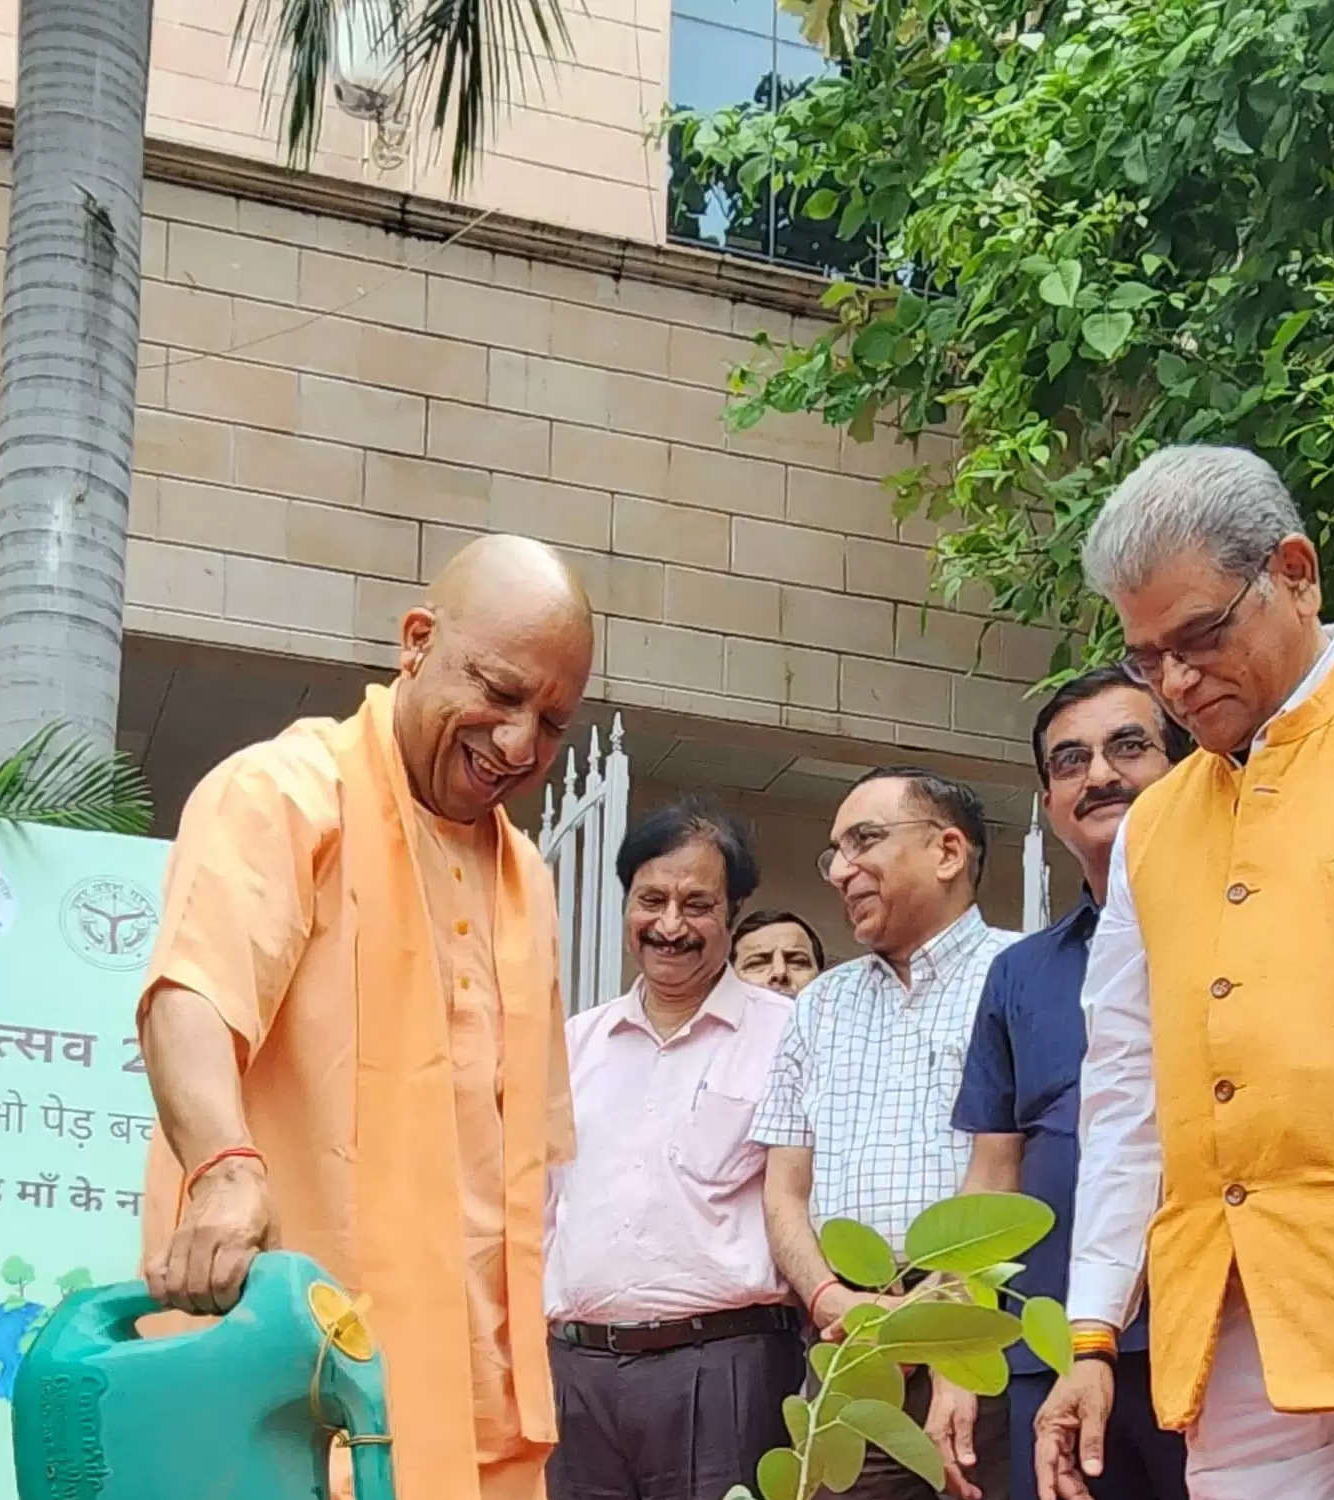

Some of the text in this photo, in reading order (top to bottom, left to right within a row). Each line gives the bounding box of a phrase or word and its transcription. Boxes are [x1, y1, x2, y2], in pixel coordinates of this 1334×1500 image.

[40, 1094, 95, 1149] पेड़
[16, 1172, 60, 1208] माँ
[69, 1176, 105, 1211] के
